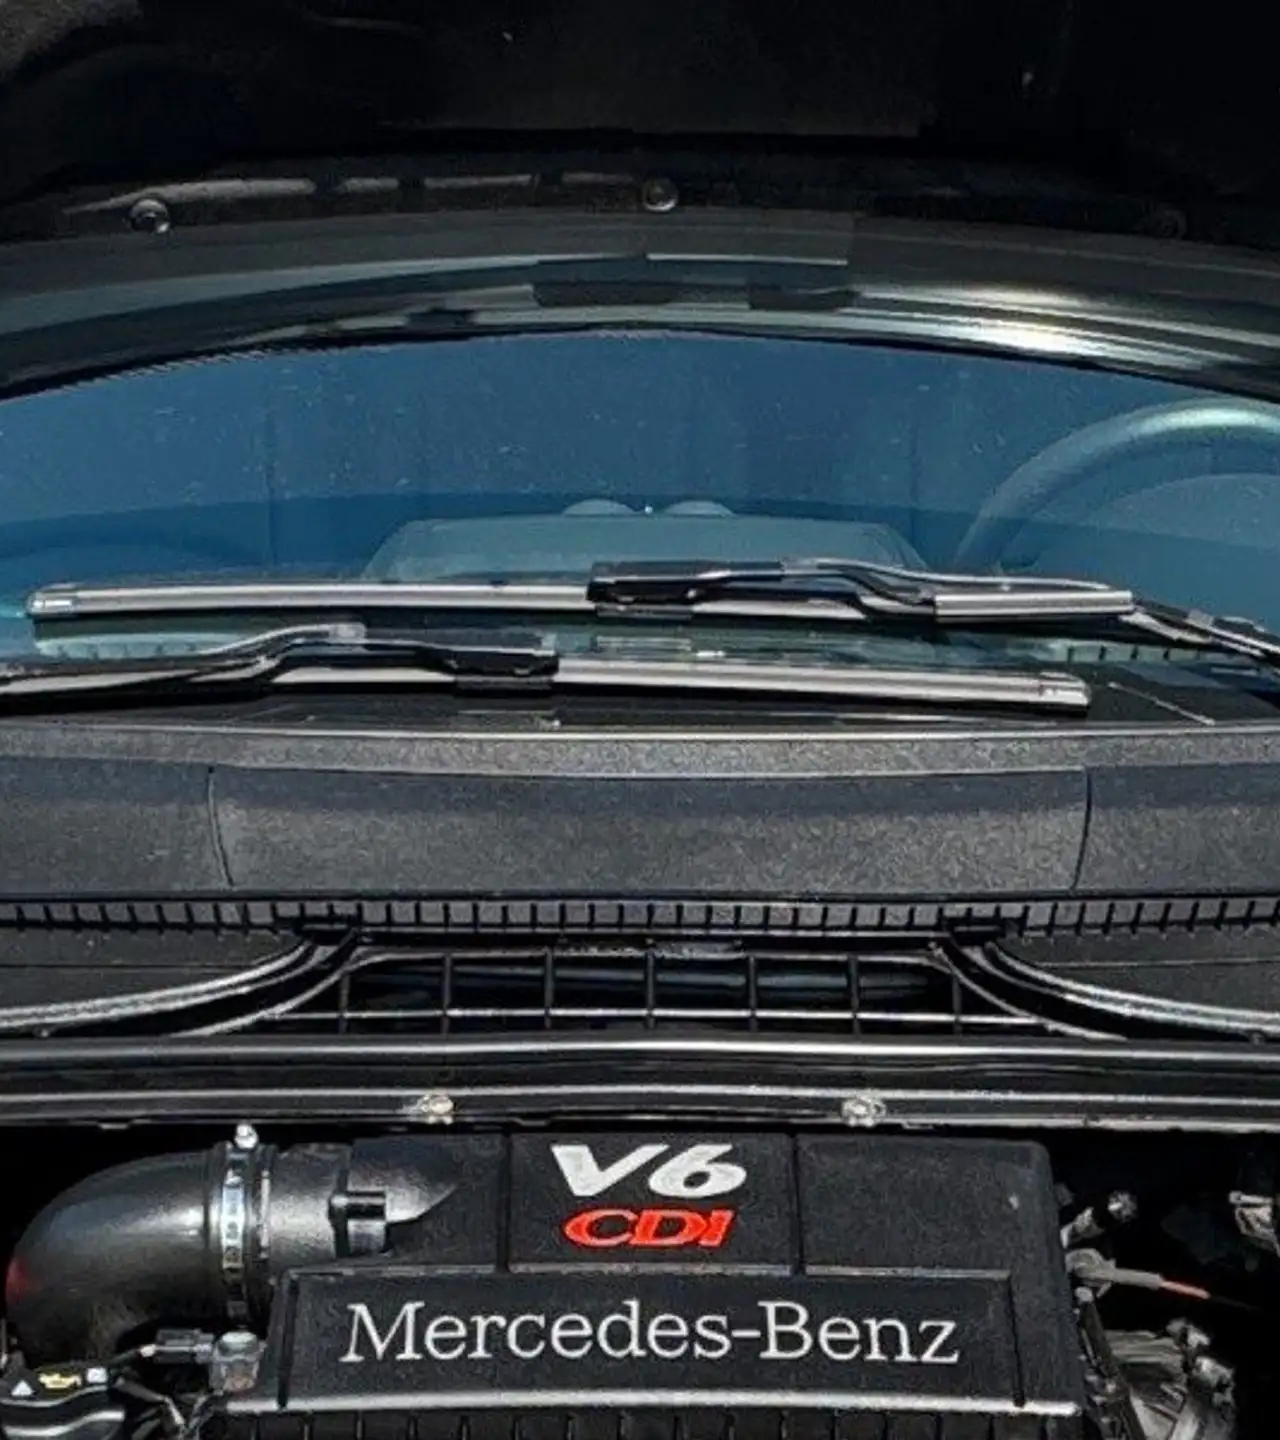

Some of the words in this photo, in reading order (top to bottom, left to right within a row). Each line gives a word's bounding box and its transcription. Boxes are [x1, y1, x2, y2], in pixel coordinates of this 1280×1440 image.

[550, 1142, 748, 1198] V6
[562, 1207, 734, 1247] CDI
[339, 1299, 960, 1364] Mercedes-Benz
